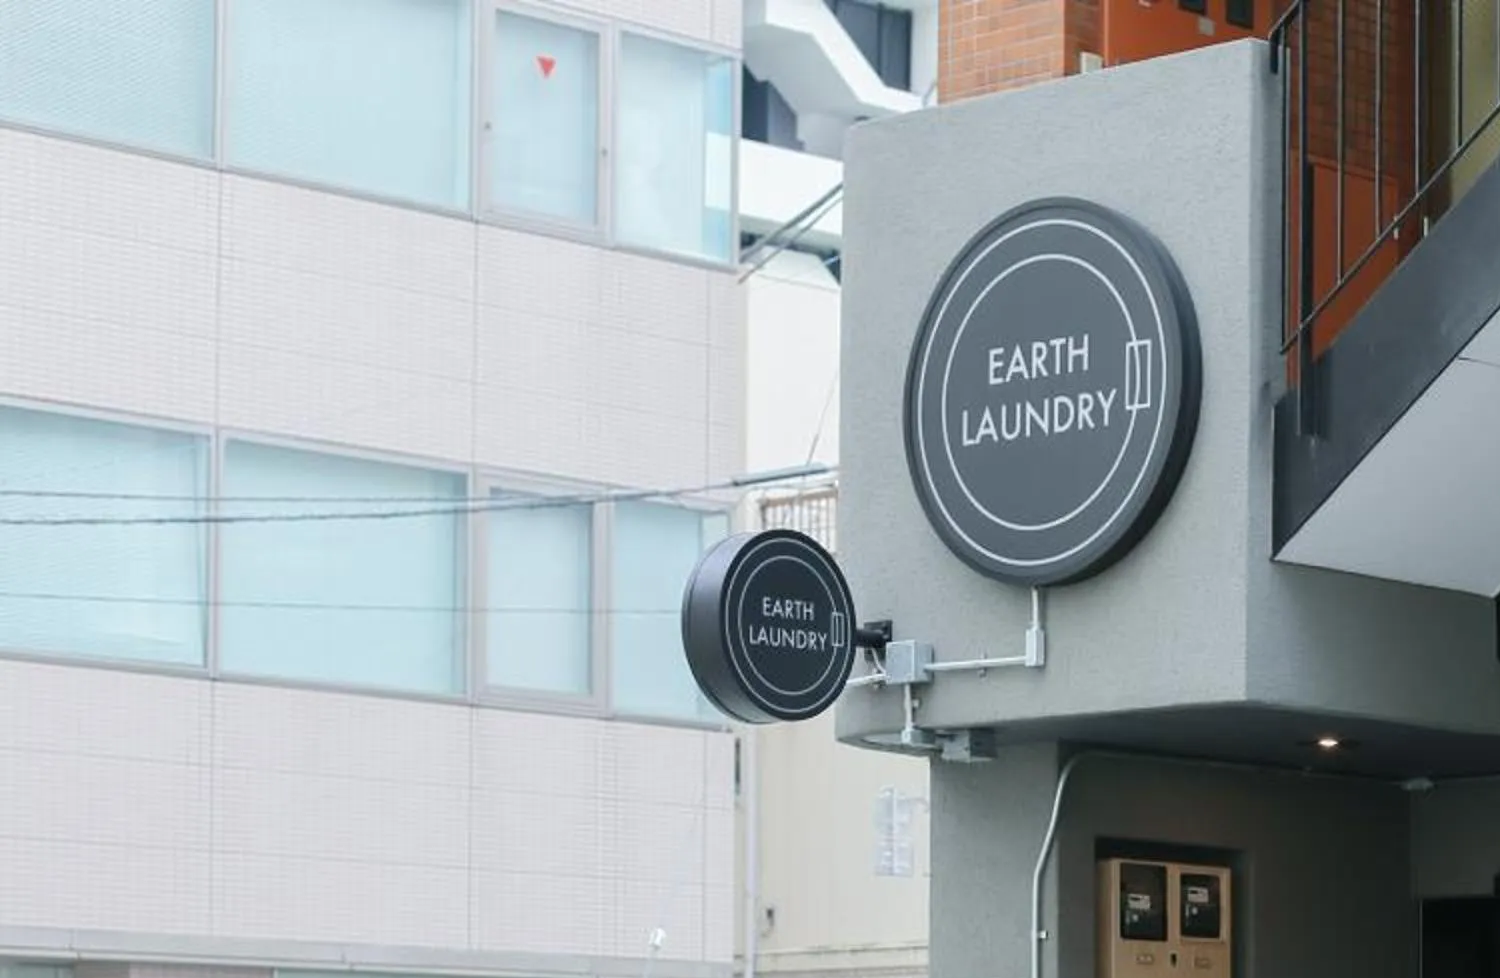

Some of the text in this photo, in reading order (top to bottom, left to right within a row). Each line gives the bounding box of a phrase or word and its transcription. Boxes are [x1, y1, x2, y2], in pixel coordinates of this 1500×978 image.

[988, 333, 1089, 385] EARTH
[962, 388, 1117, 446] LAUNDRY
[762, 596, 815, 621] EARTH
[749, 624, 828, 652] LAUNDRY
